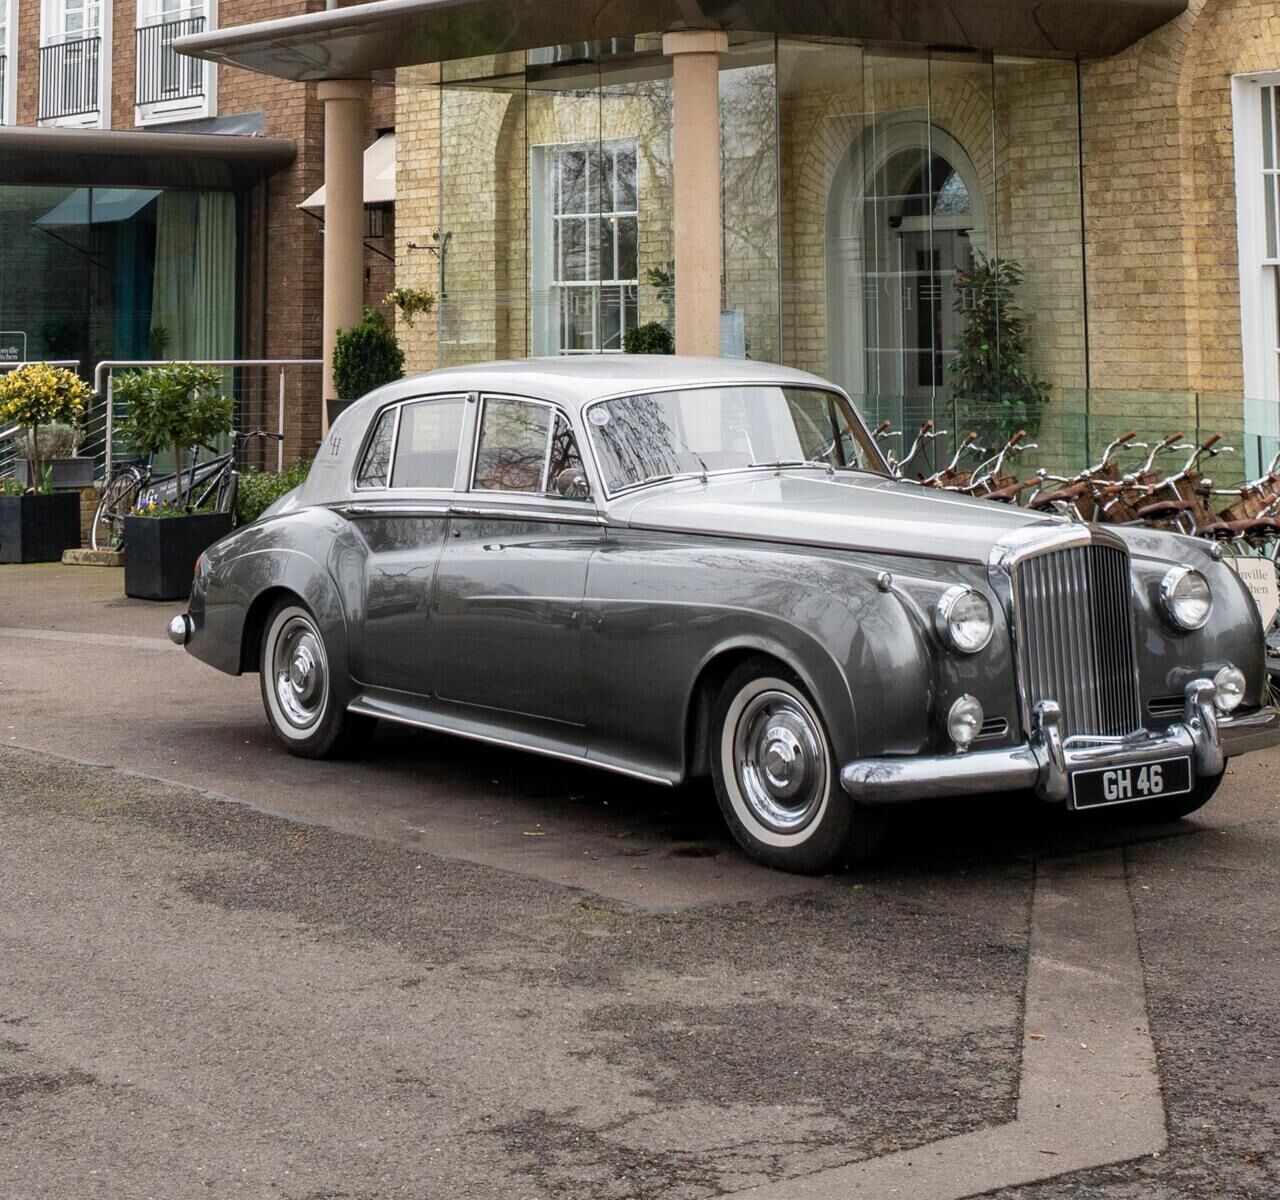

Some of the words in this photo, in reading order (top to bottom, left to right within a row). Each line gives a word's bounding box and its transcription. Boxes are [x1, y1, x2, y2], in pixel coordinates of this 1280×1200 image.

[1240, 569, 1268, 580] nville
[1103, 769, 1132, 800] GH
[1137, 765, 1163, 795] 46
